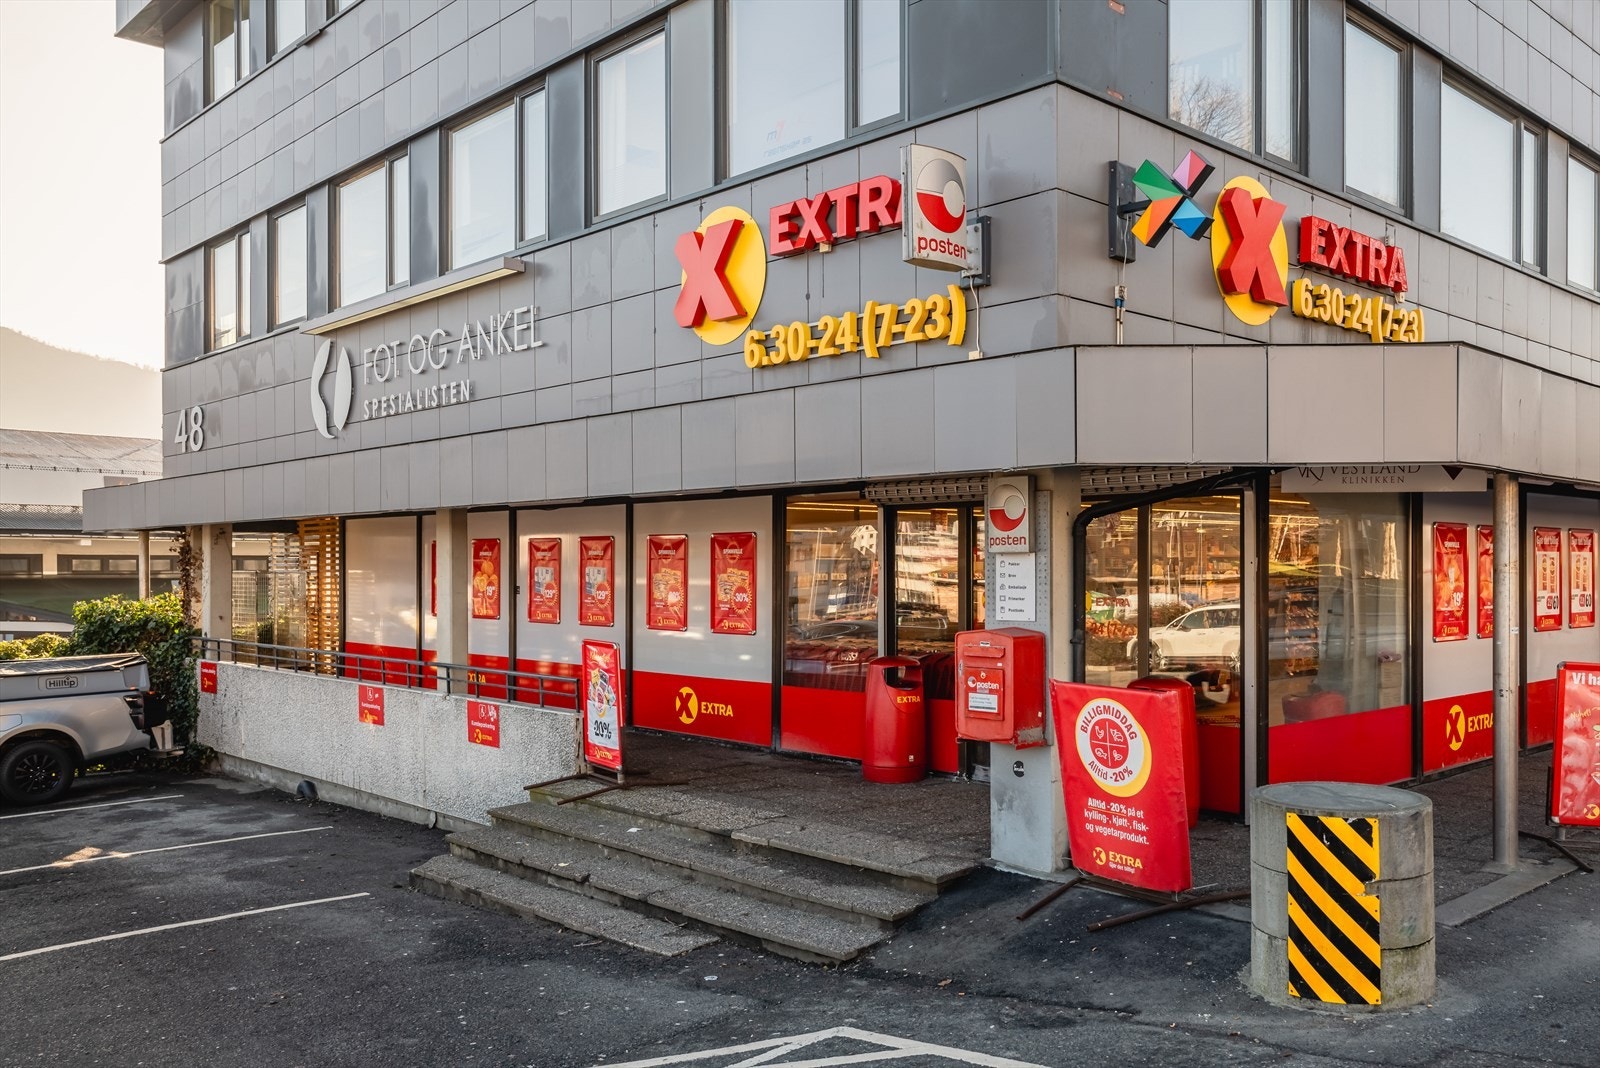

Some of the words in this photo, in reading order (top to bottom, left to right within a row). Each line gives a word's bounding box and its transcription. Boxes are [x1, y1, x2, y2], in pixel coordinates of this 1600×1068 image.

[770, 175, 902, 256] EXTR
[917, 235, 967, 259] posten
[1301, 216, 1408, 292] EXTRA
[364, 340, 400, 385] FOT
[408, 328, 448, 375] OG
[457, 305, 543, 364] ANKEL
[363, 379, 470, 420] SPESIALISTEN
[174, 406, 204, 453] 48
[1342, 476, 1404, 484] KLINIKKEN
[989, 534, 1027, 548] posten
[1095, 597, 1130, 607] EXTRA
[48, 676, 76, 688] Hilltip
[976, 681, 999, 690] posten
[1572, 672, 1585, 685] Vi
[701, 701, 734, 717] EXTRA
[897, 695, 920, 704] EXTRA
[1081, 704, 1137, 741] BILLIGMIDDAG
[1088, 760, 1108, 780] Alltid
[1110, 766, 1133, 782] -20%
[1088, 797, 1106, 810] Alltid
[1128, 806, 1136, 817] på
[1137, 810, 1144, 819] et
[1084, 809, 1112, 824] kylling-,
[1112, 815, 1132, 830] kjøtt-,
[1132, 820, 1149, 832] fisk-
[1085, 823, 1094, 833] og
[1095, 825, 1150, 845] vegetarprodukt.
[1109, 851, 1143, 869] EXTRA
